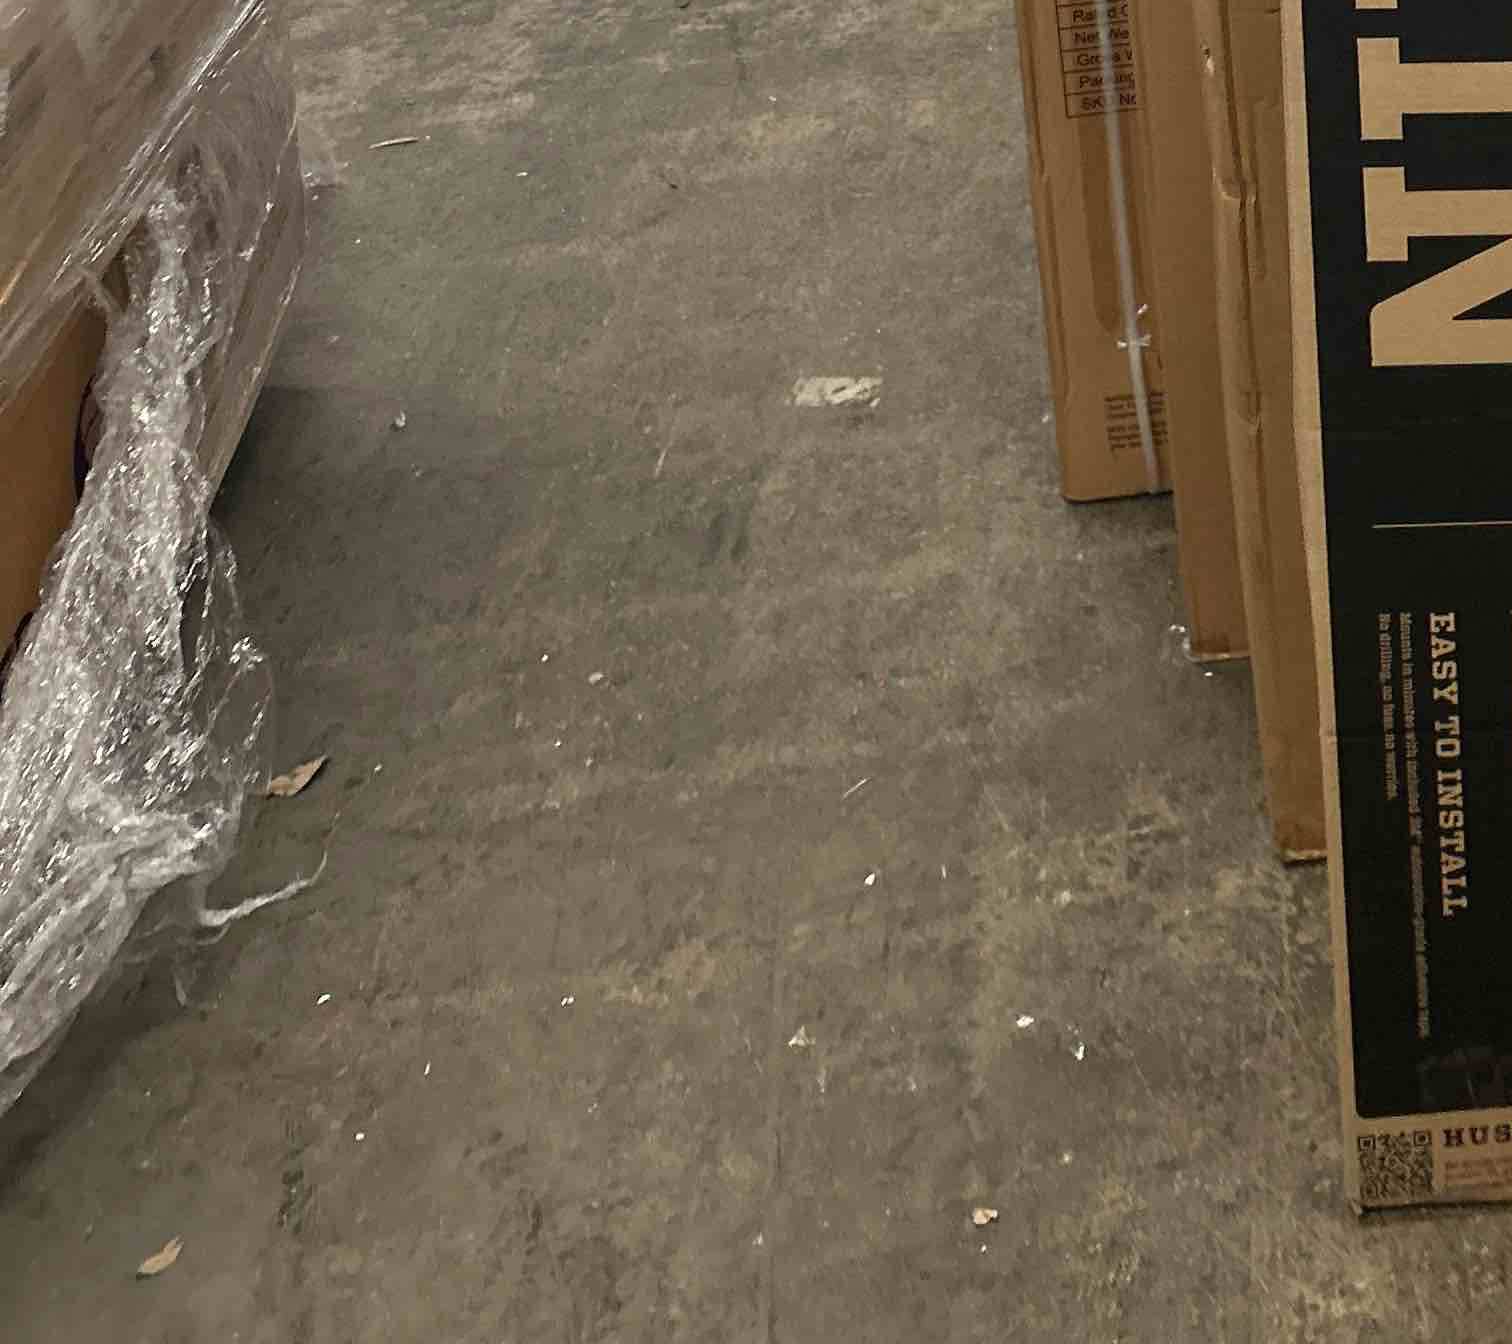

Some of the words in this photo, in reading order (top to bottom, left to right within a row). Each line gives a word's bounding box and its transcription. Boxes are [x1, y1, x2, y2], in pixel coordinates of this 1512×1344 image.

[1072, 5, 1117, 23] Rad
[1076, 51, 1121, 66] Gros
[1079, 70, 1135, 89] Paing
[1081, 95, 1105, 111] SK
[1428, 611, 1459, 705] EASY
[1435, 714, 1461, 760] TO
[1437, 770, 1469, 917] INSTALL
